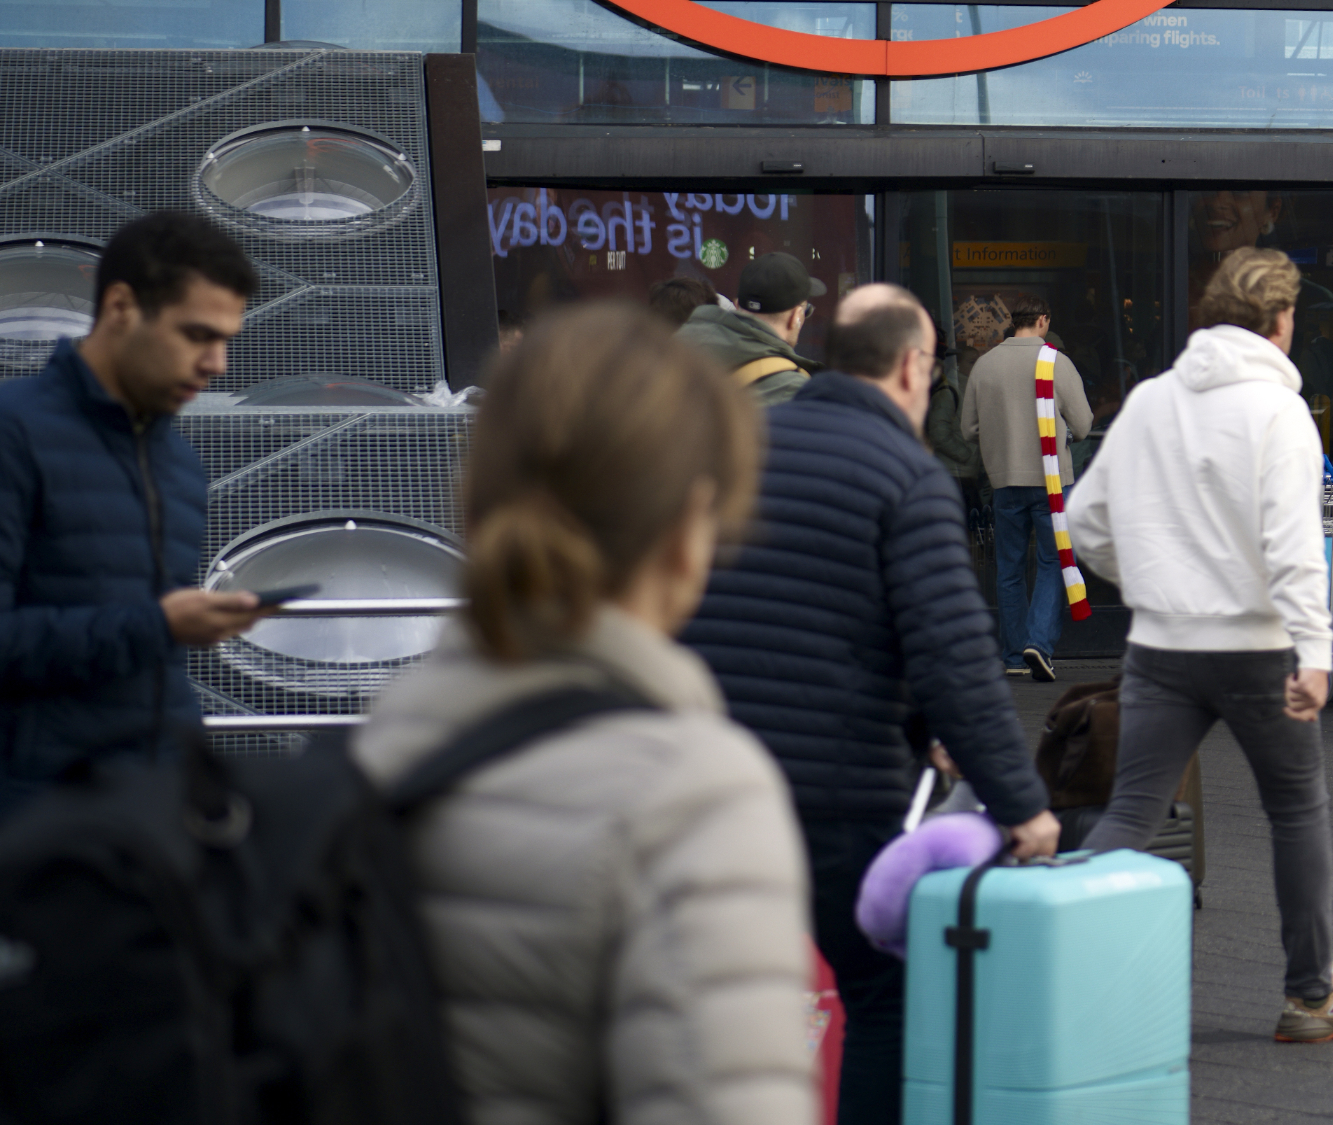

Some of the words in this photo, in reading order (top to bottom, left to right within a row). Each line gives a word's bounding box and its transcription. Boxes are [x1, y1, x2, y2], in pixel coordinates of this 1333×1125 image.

[1163, 29, 1221, 49] flights.
[1238, 85, 1290, 99] Toilts
[967, 246, 1056, 261] Information
